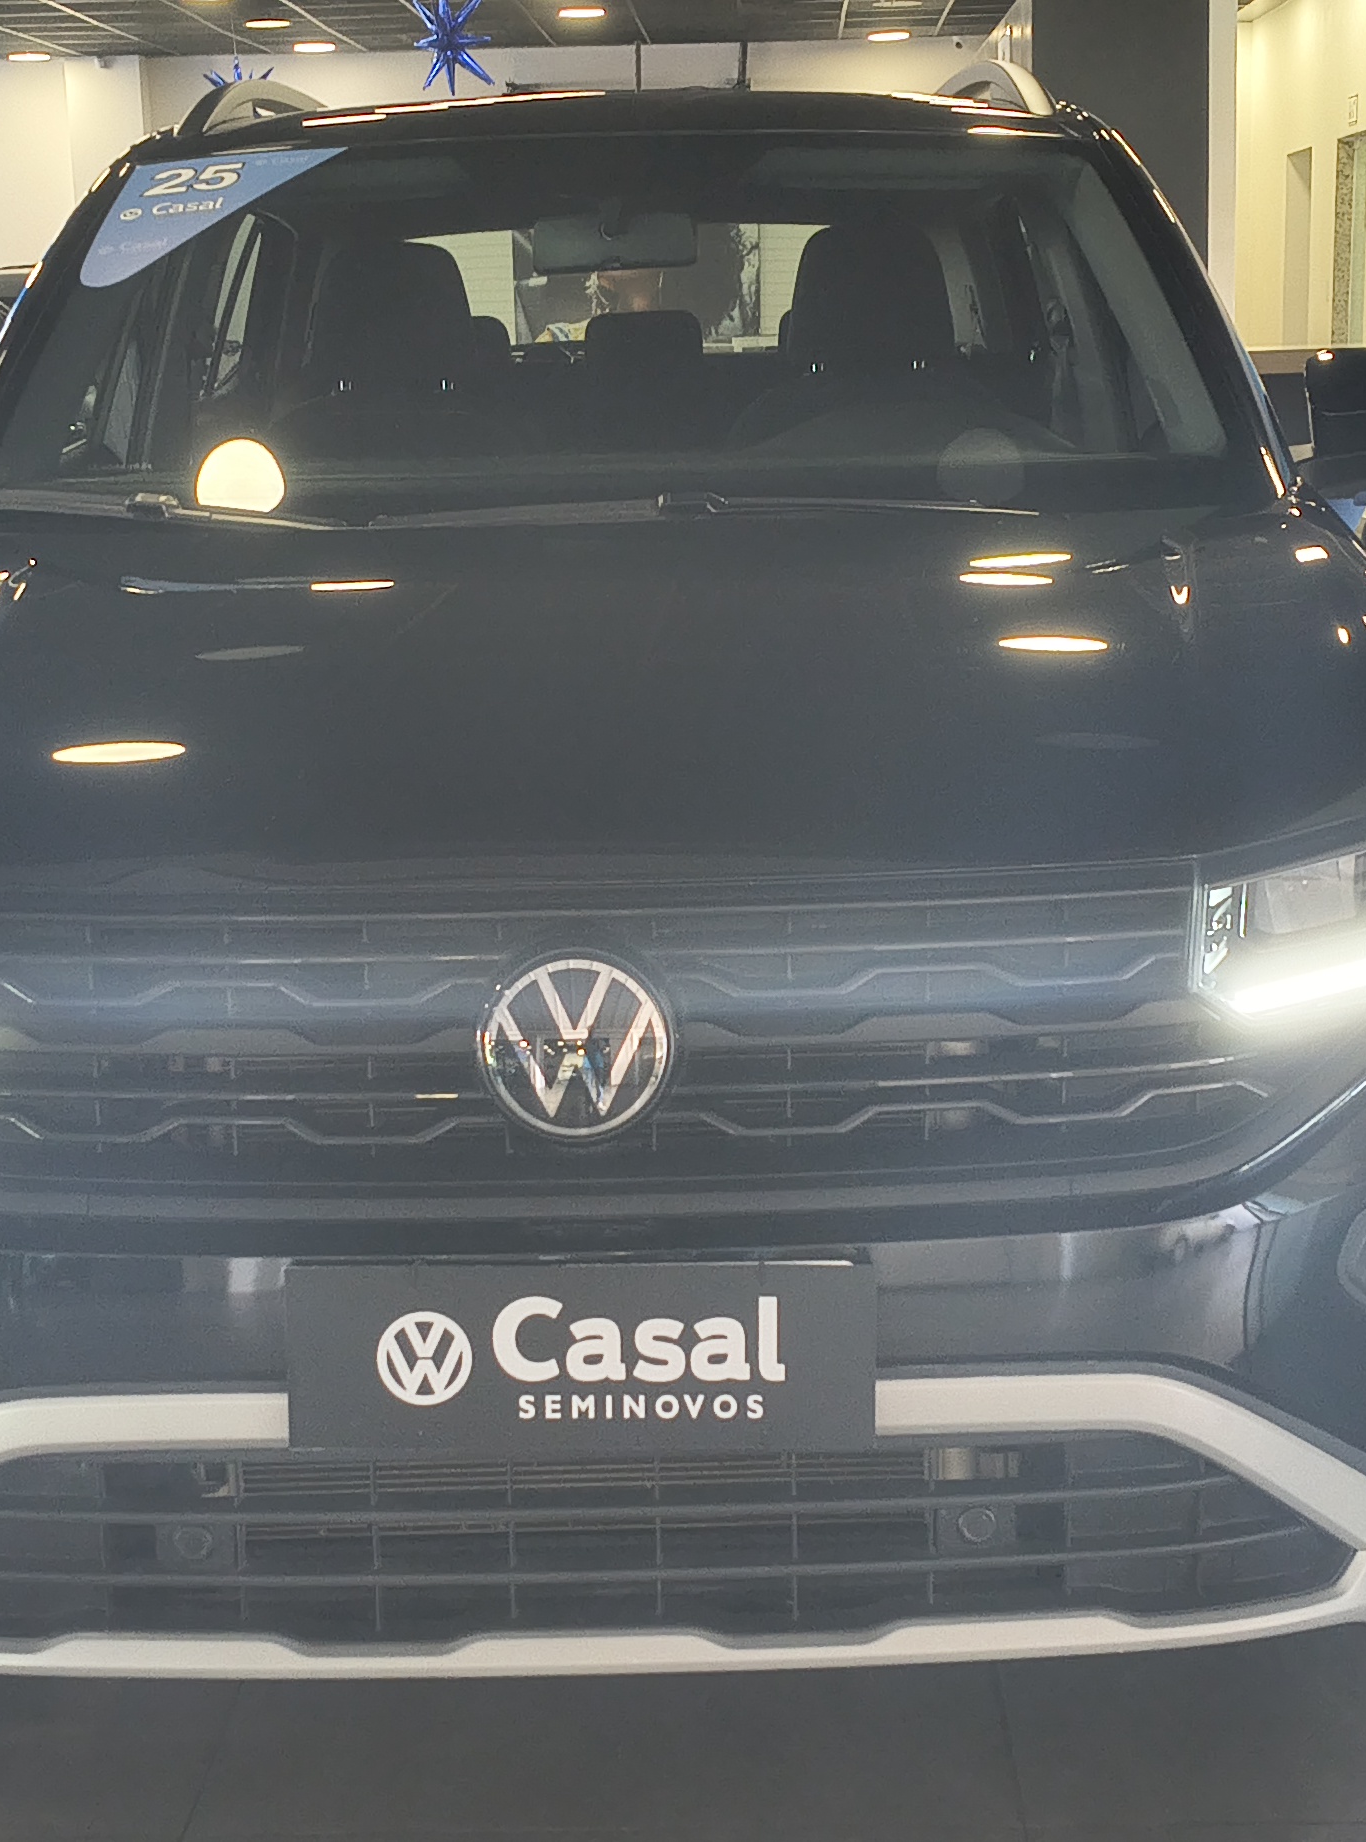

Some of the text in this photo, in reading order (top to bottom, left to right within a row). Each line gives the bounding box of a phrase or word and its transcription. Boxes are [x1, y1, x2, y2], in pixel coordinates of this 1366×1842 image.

[141, 162, 245, 197] 25
[152, 197, 224, 216] Casal
[492, 1295, 786, 1383] Casal
[518, 1393, 765, 1420] SEMINOVOS
